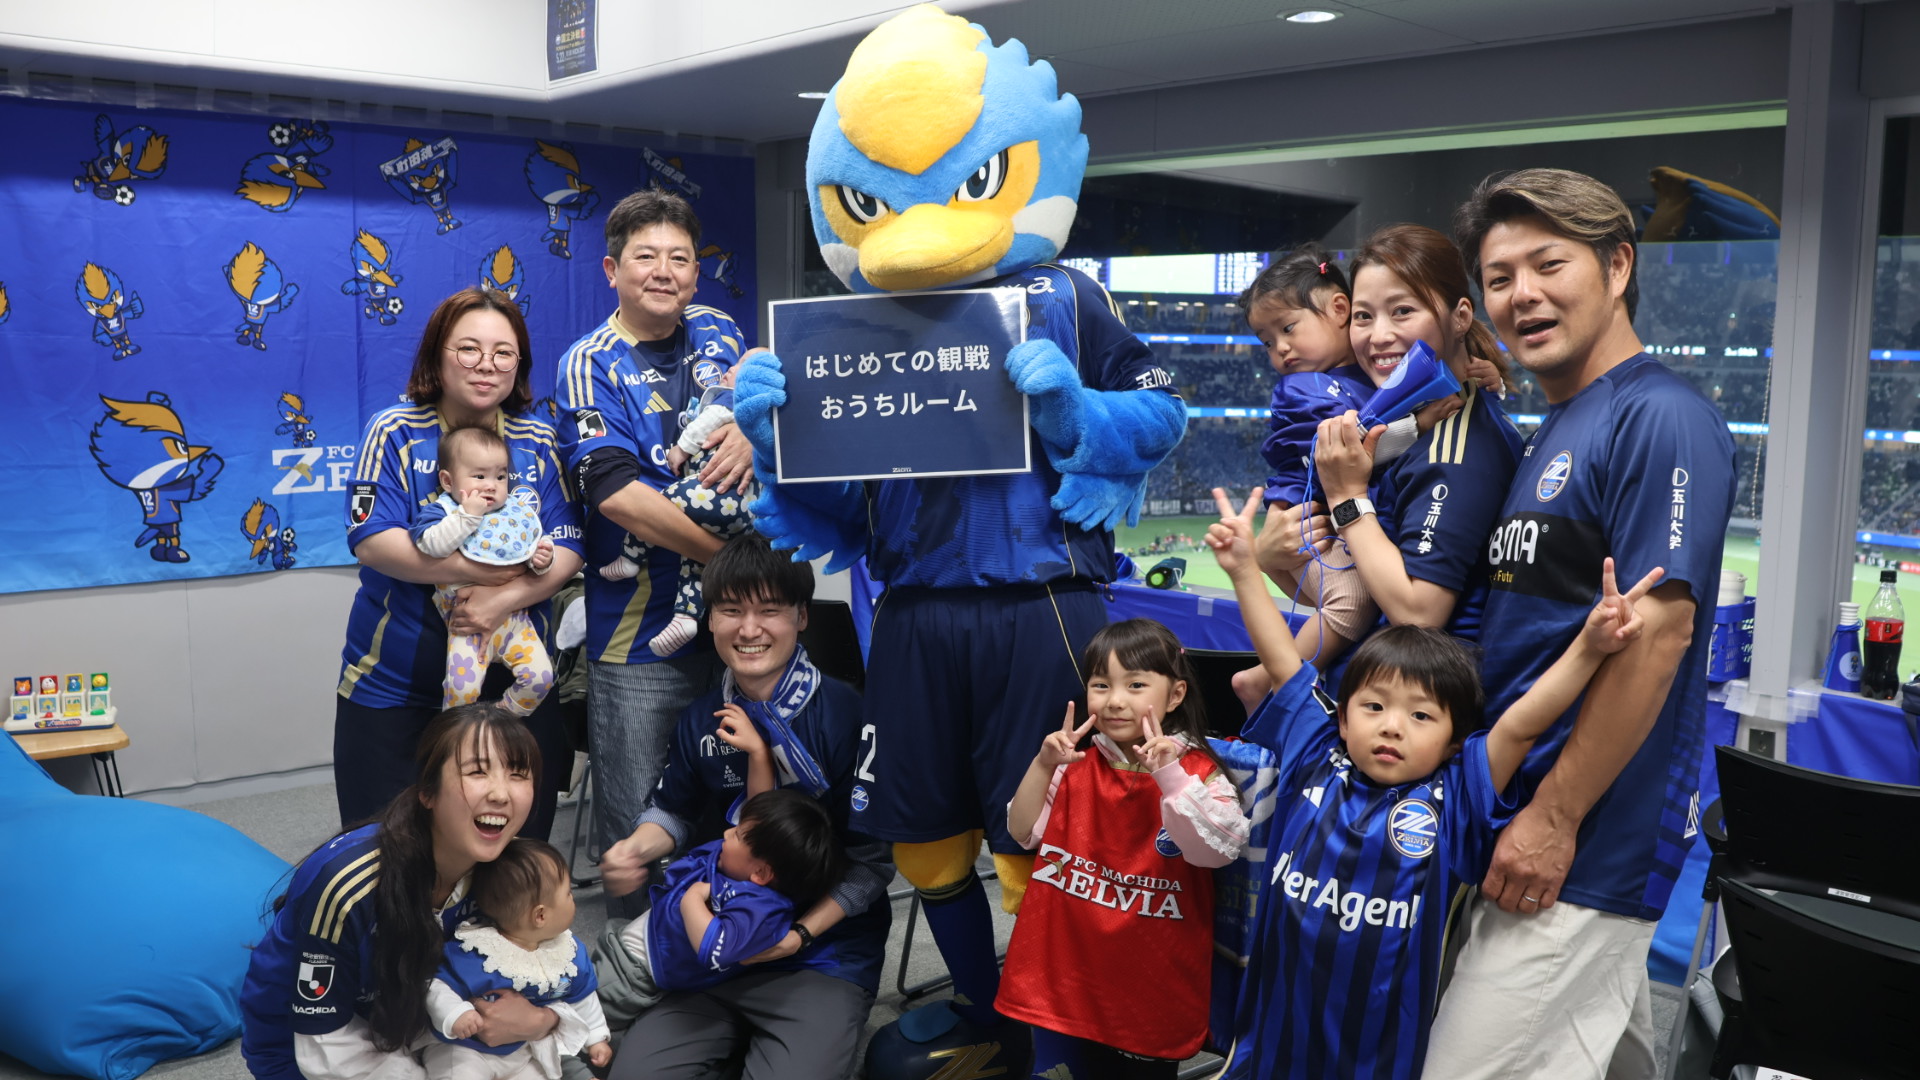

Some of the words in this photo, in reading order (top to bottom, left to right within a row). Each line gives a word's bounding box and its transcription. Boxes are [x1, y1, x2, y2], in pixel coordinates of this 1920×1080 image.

[806, 345, 990, 378] はじめての観戦
[821, 390, 978, 420] おうちルーム
[326, 445, 355, 459] FC
[139, 491, 155, 506] 12
[1417, 501, 1444, 554] 玉川大学
[1669, 488, 1686, 550] 玉川大学
[854, 723, 876, 783] 2
[1396, 832, 1430, 847] ZELVIA
[1031, 843, 1184, 920] ZELVIA
[1073, 855, 1097, 872] FC
[1101, 865, 1182, 892] MACHIDA
